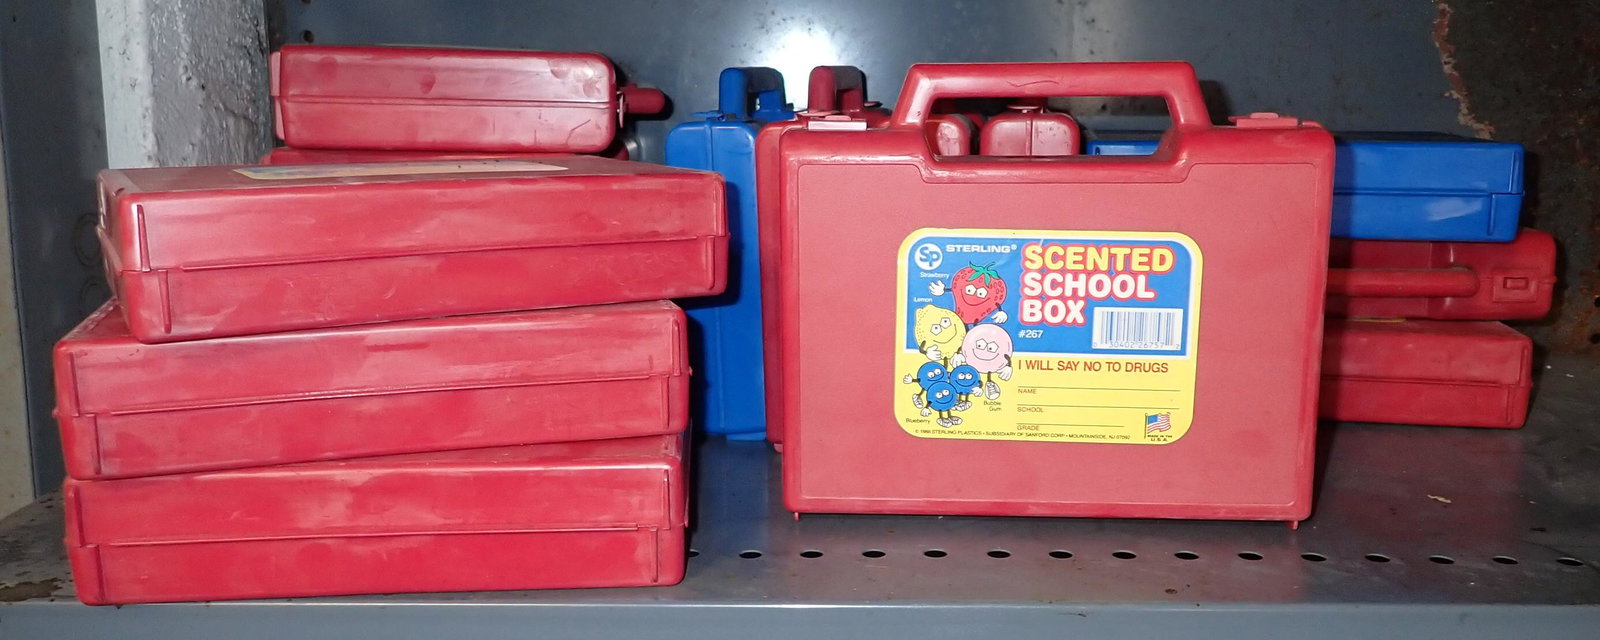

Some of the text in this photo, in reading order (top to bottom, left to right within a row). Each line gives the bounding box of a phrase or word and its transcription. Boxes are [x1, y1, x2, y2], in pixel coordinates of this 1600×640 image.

[1023, 244, 1174, 272] SCENTED
[920, 272, 950, 280] Strawberry
[1022, 272, 1156, 300] SCHOOL
[1021, 298, 1086, 324] BOX
[1018, 330, 1044, 338] #267
[1018, 360, 1169, 374] I WILL SAY NO TO DRUGS
